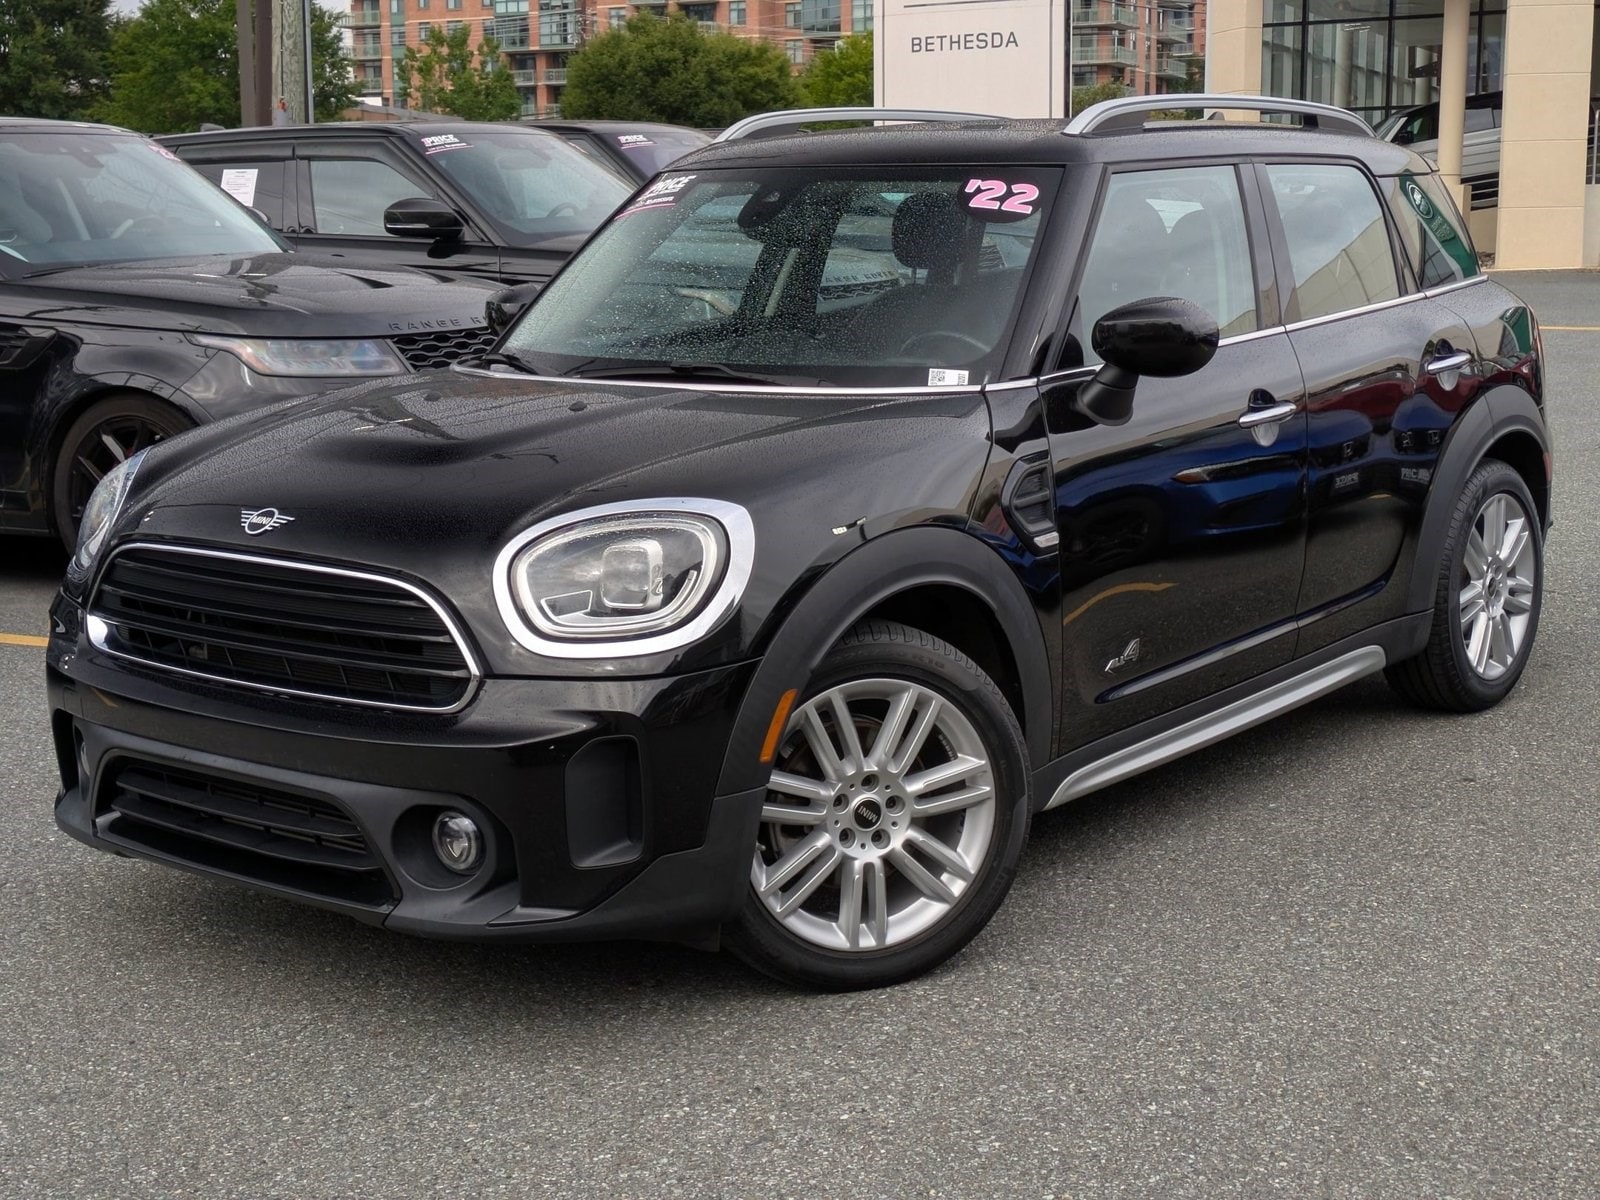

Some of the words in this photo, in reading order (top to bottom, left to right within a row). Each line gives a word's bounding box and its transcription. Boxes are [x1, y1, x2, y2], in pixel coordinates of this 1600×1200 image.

[911, 31, 1018, 53] BETHESDA
[965, 179, 1039, 214] '22
[388, 319, 461, 331] RANGE
[250, 515, 272, 525] MINI
[857, 805, 879, 823] MINI
